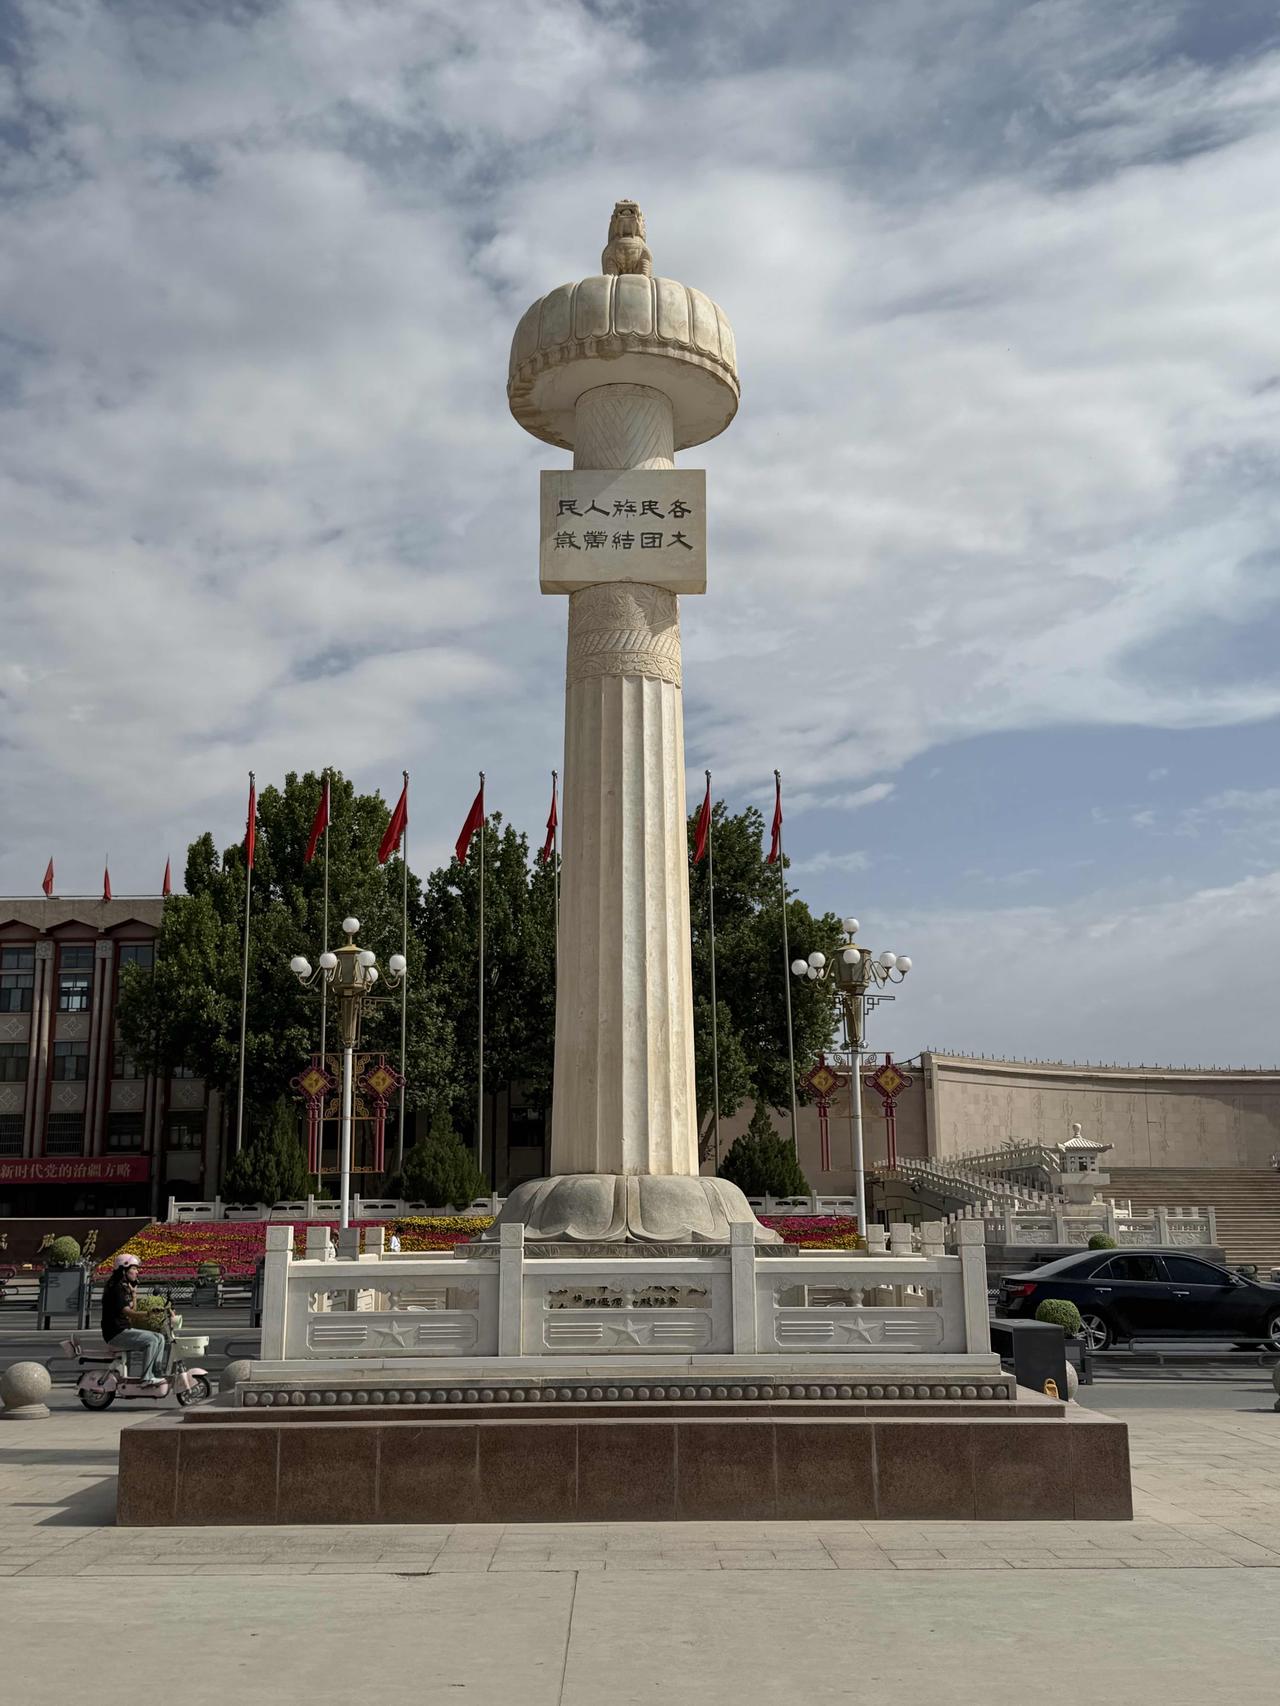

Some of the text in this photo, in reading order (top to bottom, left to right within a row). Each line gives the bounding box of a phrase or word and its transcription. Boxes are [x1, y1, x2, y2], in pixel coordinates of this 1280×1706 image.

[557, 499, 692, 519] 各民族人民
